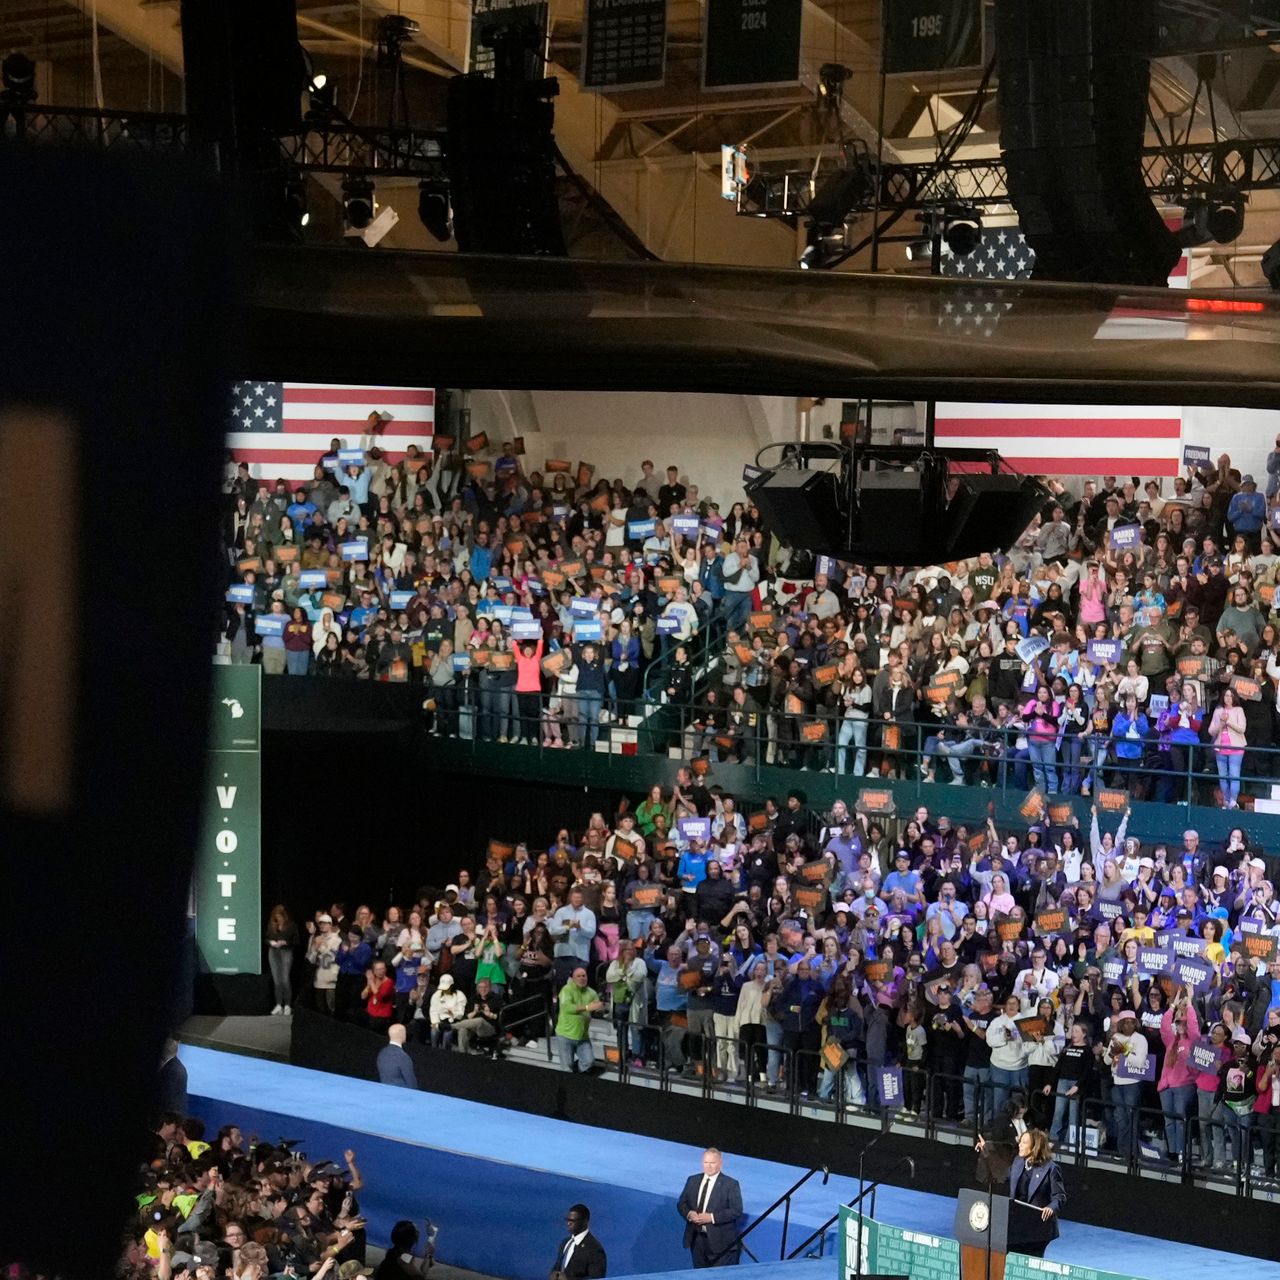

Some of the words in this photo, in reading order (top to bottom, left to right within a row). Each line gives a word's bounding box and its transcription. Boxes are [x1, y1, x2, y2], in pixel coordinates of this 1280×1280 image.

[741, 12, 767, 30] 2024
[912, 15, 943, 38] 1995
[975, 576, 994, 586] MSU
[1093, 644, 1116, 654] HARRIS
[1099, 902, 1123, 914] HARRIS
[1173, 941, 1200, 953] HARRIS
[1245, 939, 1272, 949] HARRIS
[1141, 953, 1168, 964] HARRIS
[1179, 964, 1207, 981] HARRIS
[1182, 975, 1200, 985] WALZ
[1193, 1046, 1215, 1061] HARRIS
[1195, 1056, 1211, 1067] WALZ
[1127, 1066, 1146, 1074] WALZ
[903, 1230, 914, 1242] EAST
[1028, 1258, 1040, 1268] EAST
